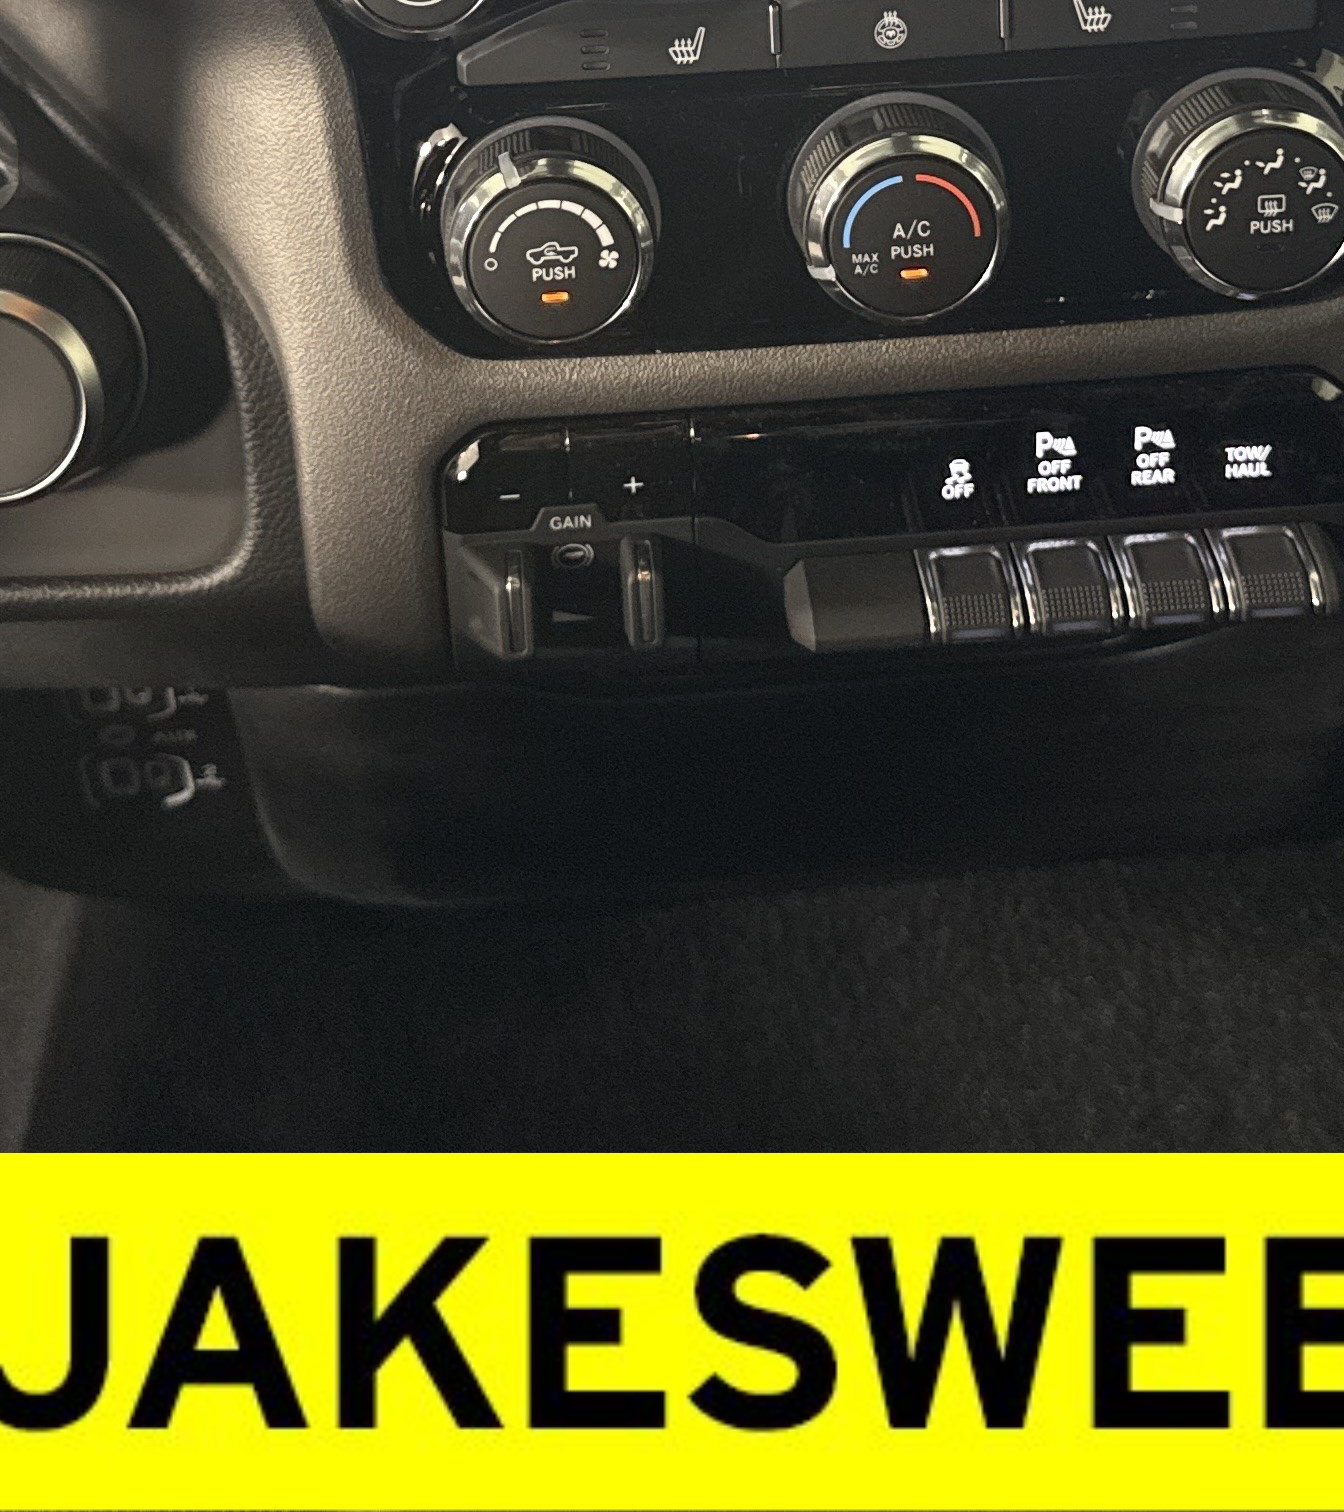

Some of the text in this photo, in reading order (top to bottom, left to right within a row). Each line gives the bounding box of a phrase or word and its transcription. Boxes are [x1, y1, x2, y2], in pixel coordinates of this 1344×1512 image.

[892, 220, 932, 240] A/C
[1249, 218, 1294, 234] PUSH
[851, 252, 880, 265] MAX
[890, 243, 935, 261] PUSH
[531, 265, 577, 282] PUSH
[853, 263, 879, 276] A/C
[1136, 451, 1170, 469] OFF
[1224, 444, 1273, 462] TOW/
[1037, 458, 1071, 476] OFF
[1224, 461, 1273, 480] HAUL
[1027, 474, 1083, 494] FRONT
[1131, 467, 1176, 487] REAR
[941, 483, 974, 501] OFF
[549, 513, 592, 531] GAIN
